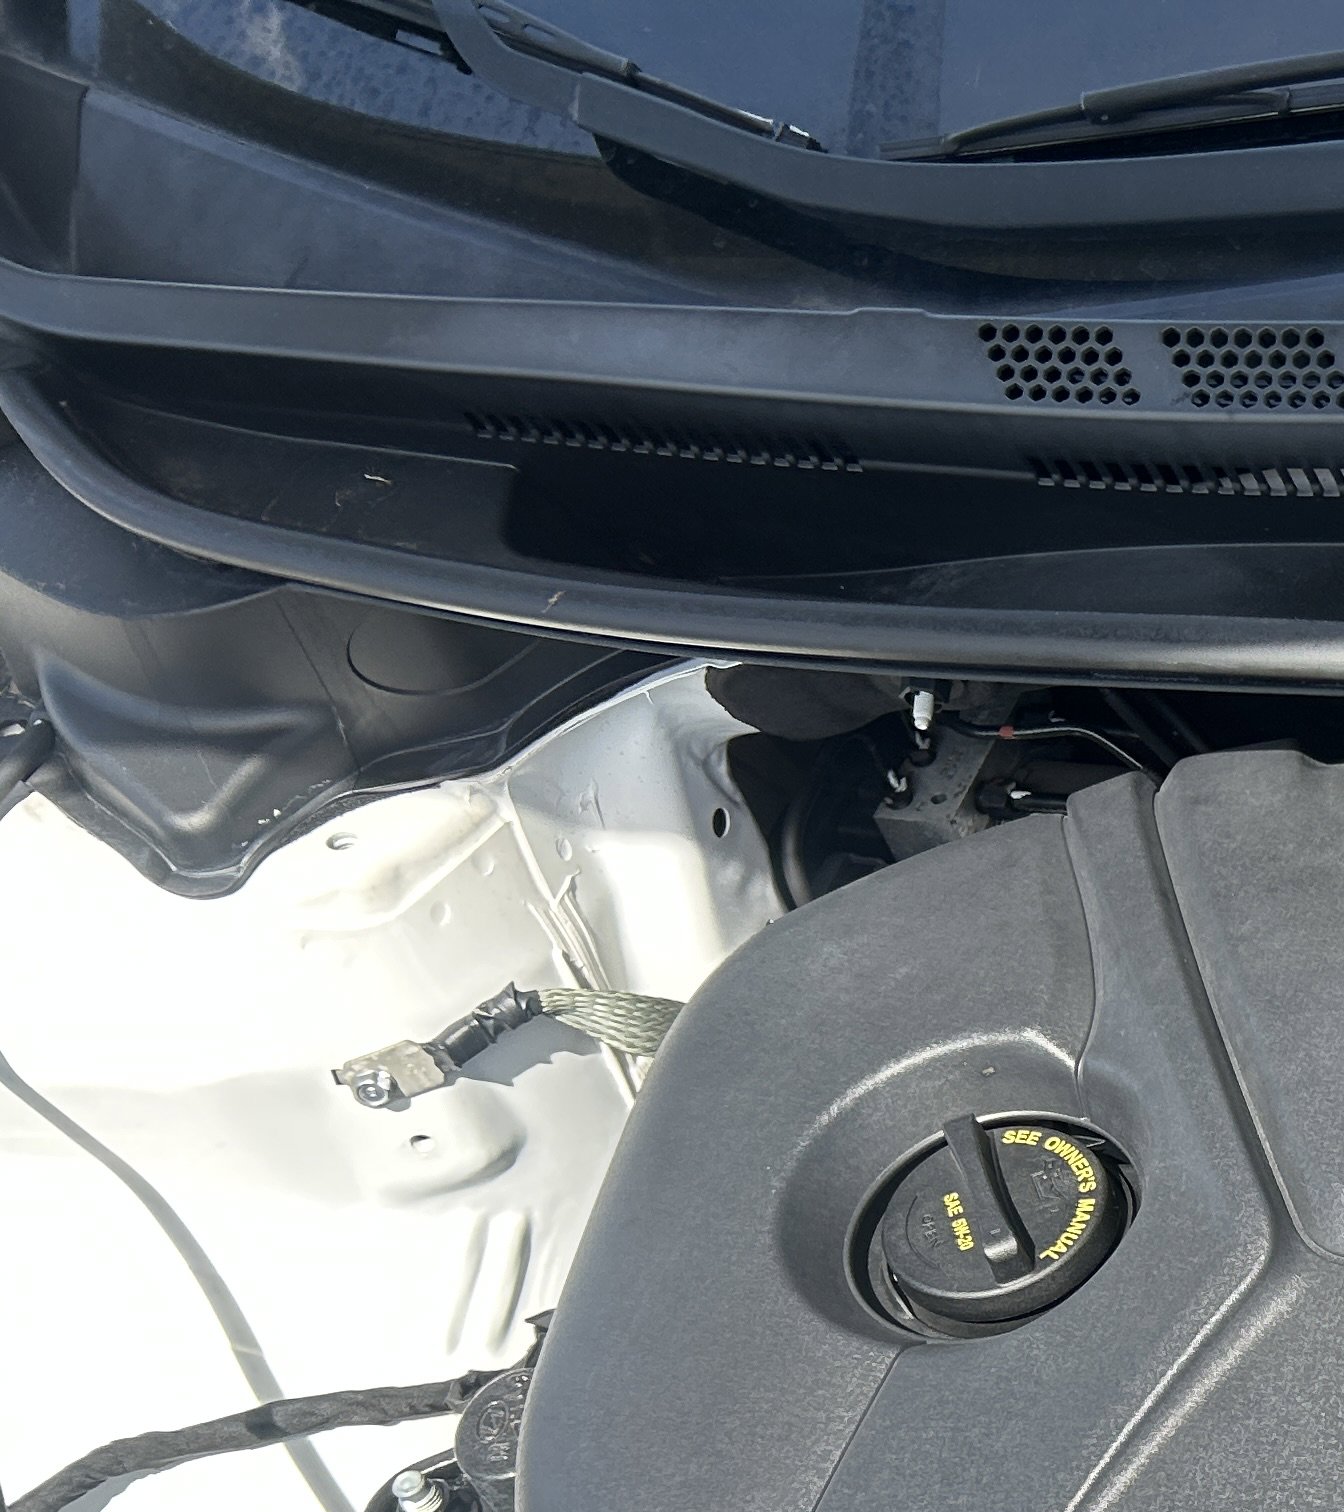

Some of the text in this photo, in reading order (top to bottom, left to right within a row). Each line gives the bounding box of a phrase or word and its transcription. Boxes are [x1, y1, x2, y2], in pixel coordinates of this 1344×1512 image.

[943, 1191, 965, 1218] SAE
[1001, 1129, 1097, 1261] SEE OWNER'S MANUAL
